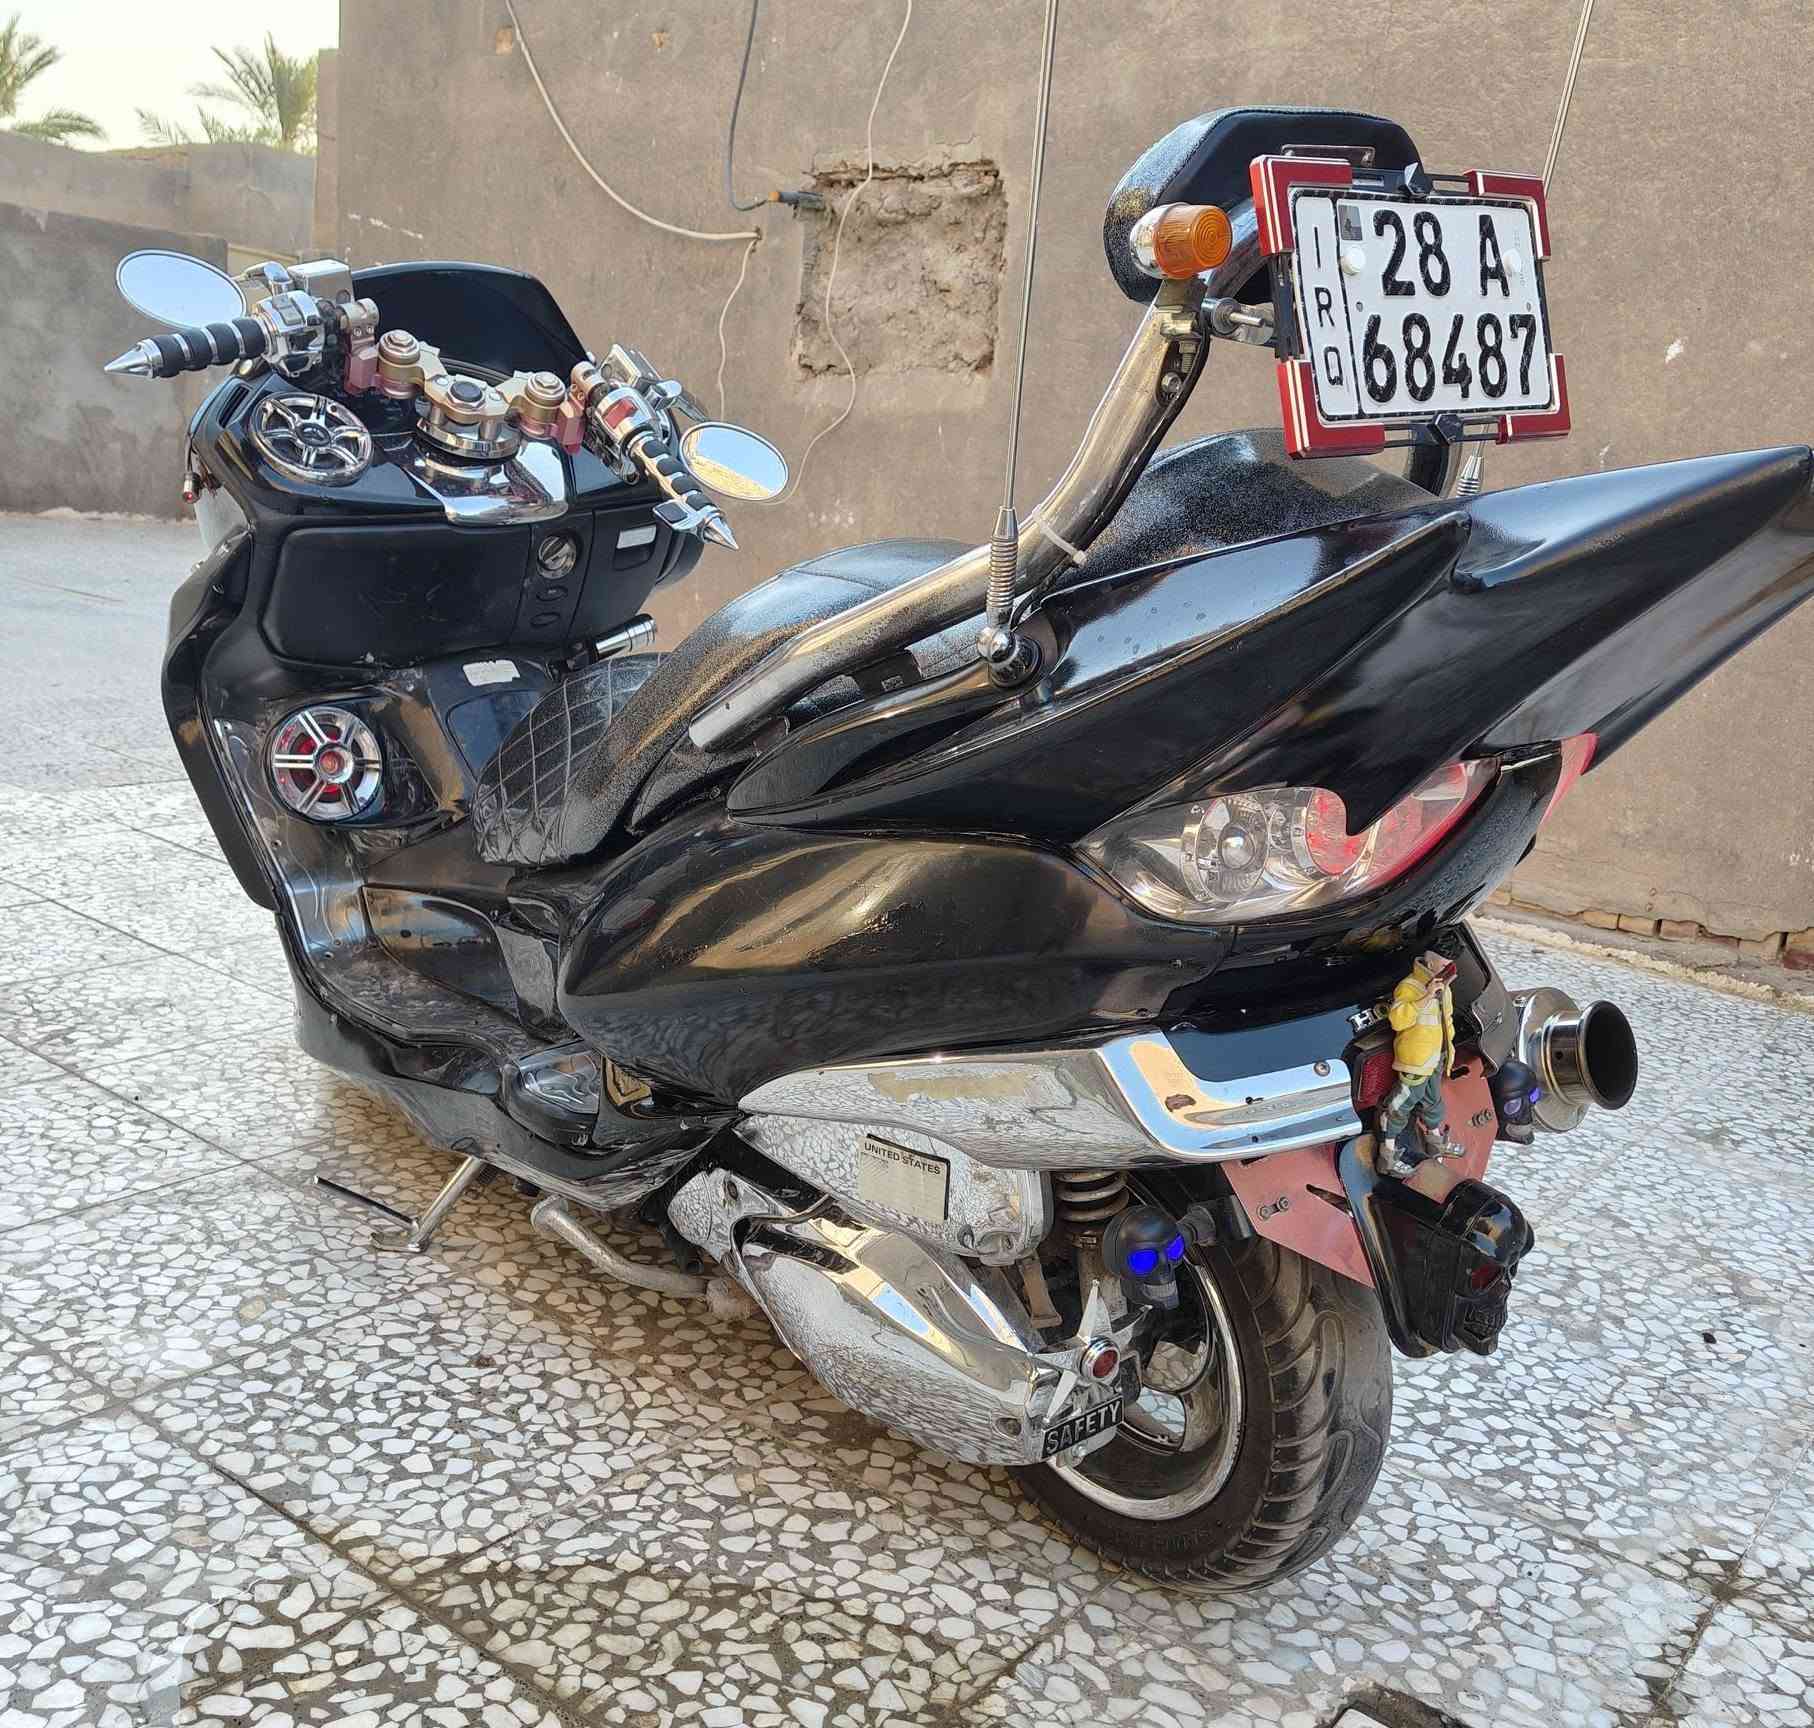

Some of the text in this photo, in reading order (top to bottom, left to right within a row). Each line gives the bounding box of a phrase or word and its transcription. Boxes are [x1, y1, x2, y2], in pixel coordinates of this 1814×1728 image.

[1373, 209, 1451, 297] 28
[1479, 214, 1510, 297] A
[1313, 226, 1343, 387] IRQ
[1362, 313, 1536, 403] 68487
[864, 1142, 941, 1175] UNITED STATES
[1046, 1402, 1121, 1452] SAFETY
